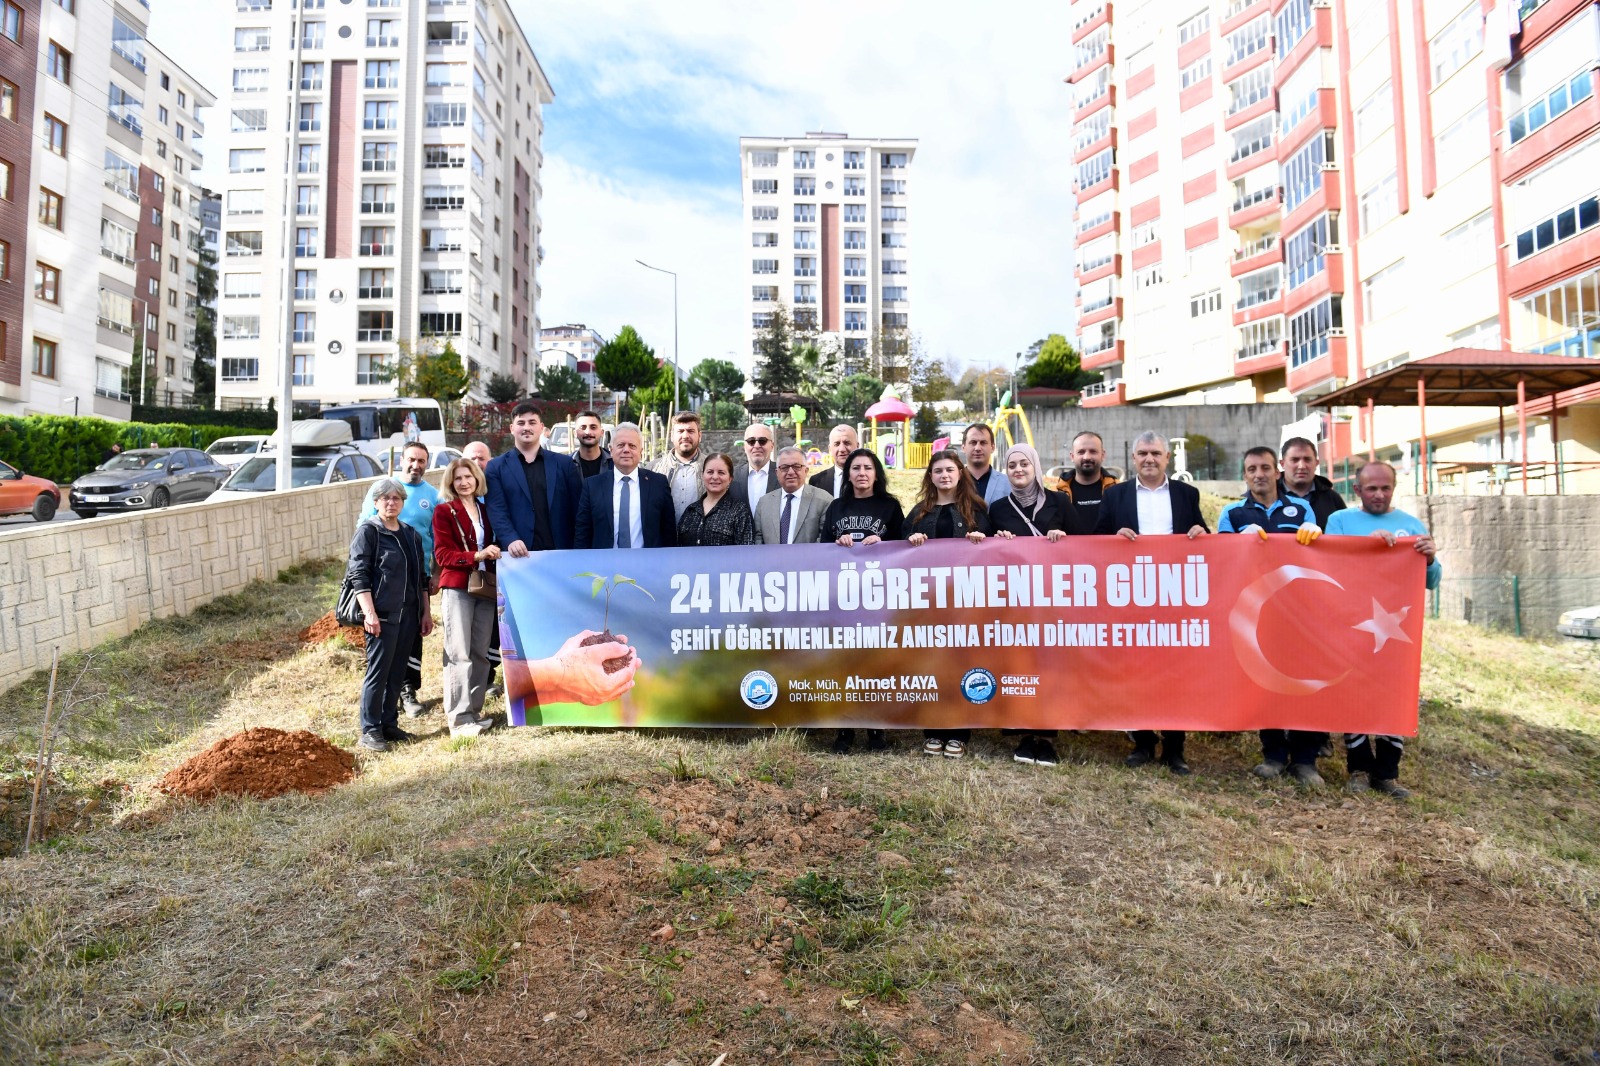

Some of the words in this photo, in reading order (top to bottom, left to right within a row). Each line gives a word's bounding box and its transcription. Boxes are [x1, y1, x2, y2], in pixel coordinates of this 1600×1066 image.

[670, 573, 713, 614] 24
[719, 570, 830, 613] KASIM
[837, 560, 1098, 611] ÖĞRETMENLER
[1105, 555, 1210, 608] GÜNÜ
[670, 624, 722, 655] ŞEHİT
[724, 622, 899, 651] ÖĞRETMENLERİMİZ
[901, 624, 981, 649] ANISINA
[983, 619, 1040, 647] FİDAN
[1043, 619, 1108, 647] DİKME
[1111, 618, 1210, 647] ETKİNLİĞİ
[788, 679, 814, 690] Mak.
[816, 679, 842, 690] Müh.
[844, 675, 897, 690] Ahmet
[900, 675, 938, 690] KAYA
[895, 692, 938, 703] BAŞKANI
